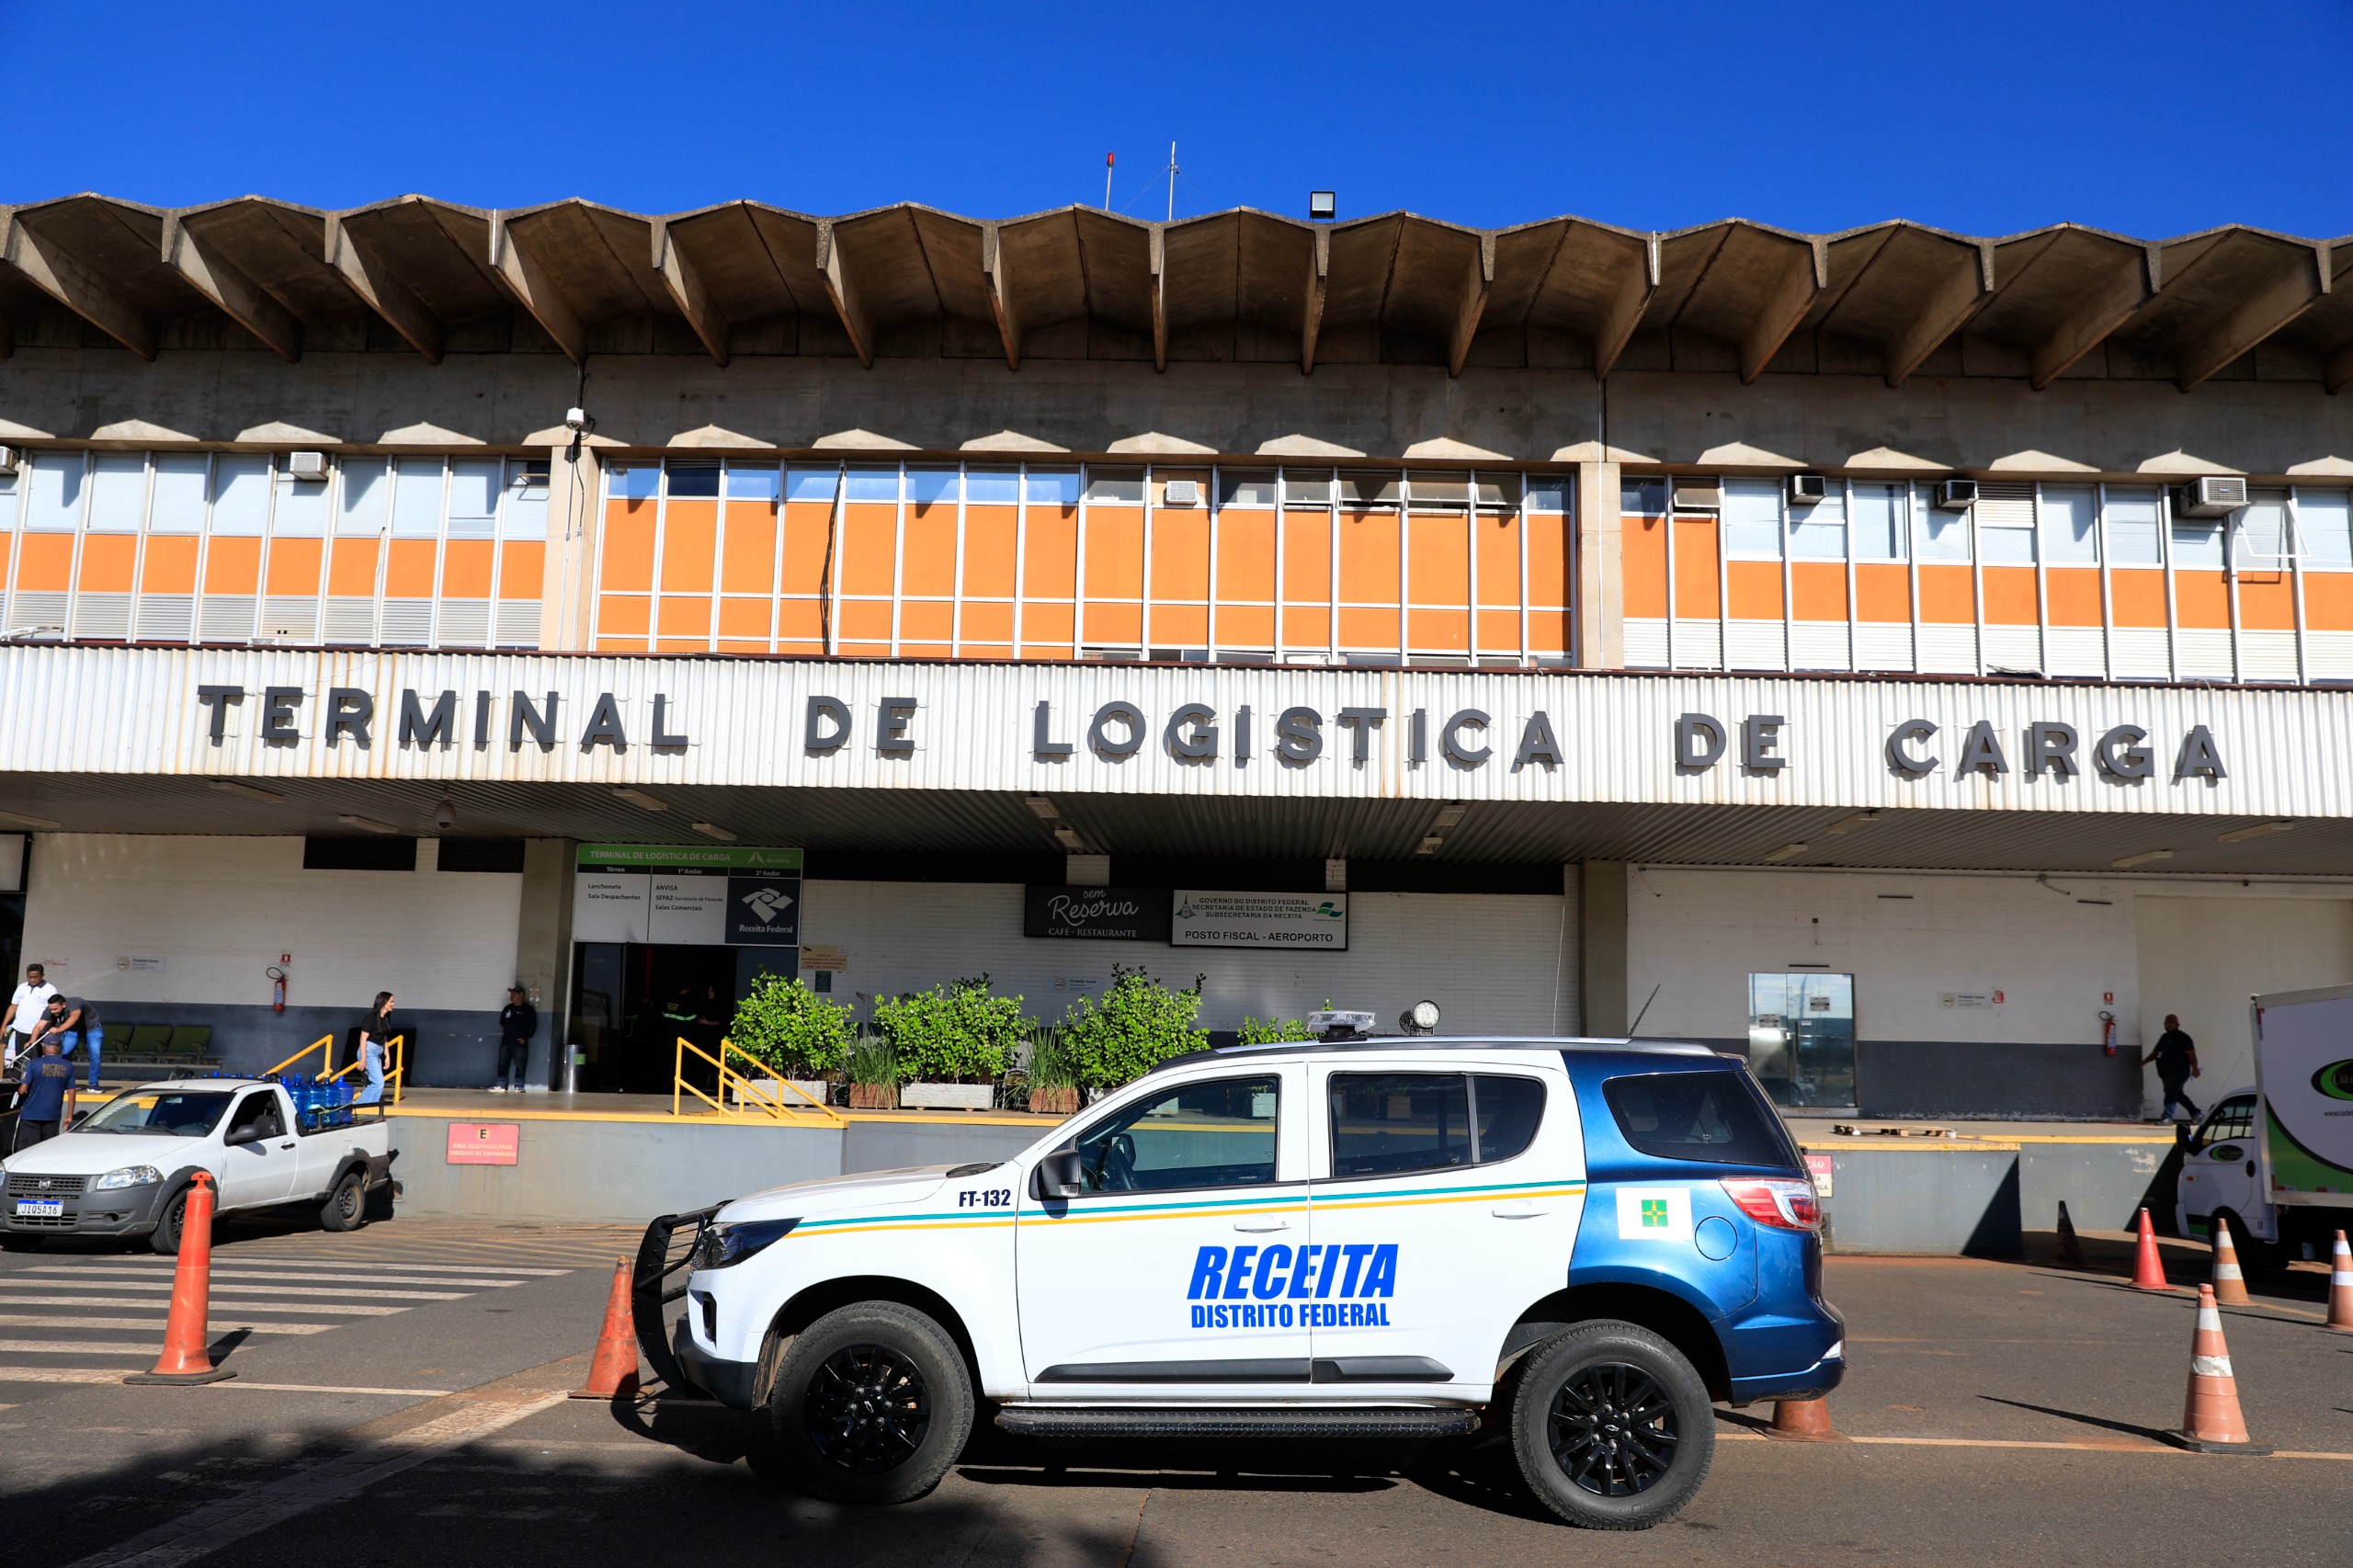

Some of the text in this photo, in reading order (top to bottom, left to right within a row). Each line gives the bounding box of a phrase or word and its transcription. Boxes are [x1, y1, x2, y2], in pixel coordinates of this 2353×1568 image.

[198, 684, 2228, 779] TERMINAL DE LOGISTICA DE CARGA
[590, 850, 731, 862] TERMINAL DE LOGÍSTICA DE CARGA
[600, 893, 641, 902] Despachantes
[1083, 889, 1107, 900] sem
[1048, 894, 1139, 926] Reserva
[739, 925, 793, 934] Receita Federal
[1048, 926, 1070, 937] CAFÉ
[1077, 928, 1137, 937] RESTAURANTE
[1185, 930, 1222, 940] POSTO
[1223, 931, 1260, 941] FISCAL
[1268, 932, 1334, 942] AEROPORTO
[480, 1129, 486, 1140] E
[959, 1188, 1011, 1208] FT-132
[1187, 1244, 1399, 1300] RECEITA
[1191, 1302, 1391, 1329] DISTRITO FEDERAL
